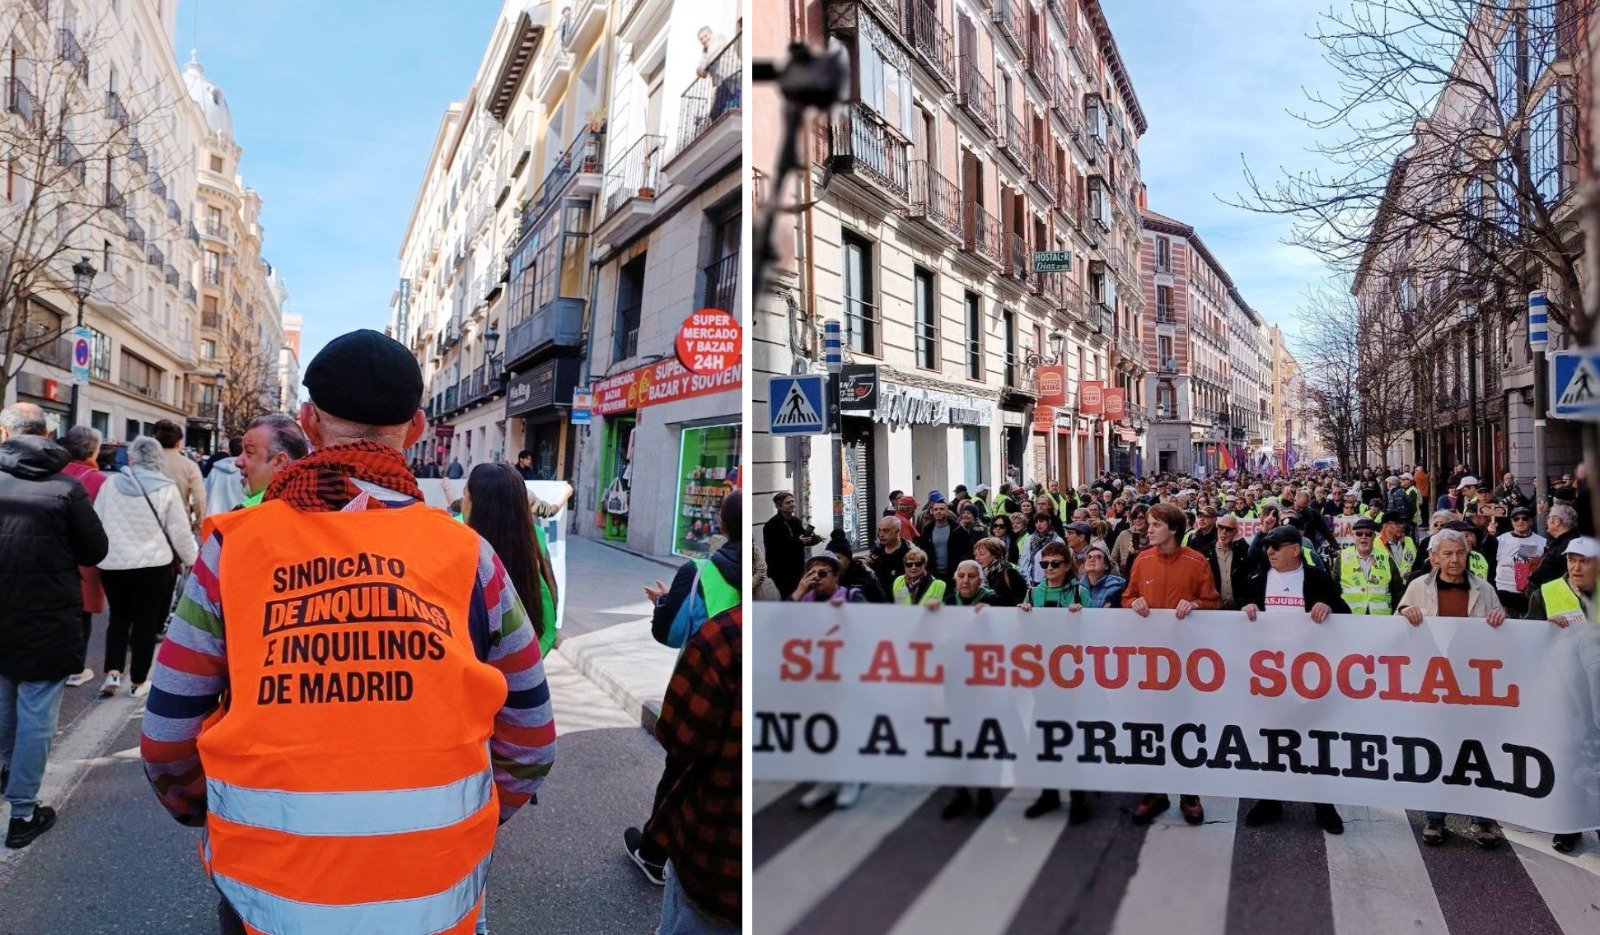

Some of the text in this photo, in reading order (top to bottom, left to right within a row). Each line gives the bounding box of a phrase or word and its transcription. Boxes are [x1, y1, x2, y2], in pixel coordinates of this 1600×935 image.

[693, 315, 730, 326] SUPER
[683, 328, 738, 339] MERCADO
[686, 342, 734, 352] Y BAZAR
[693, 355, 724, 369] 24H
[610, 372, 635, 388] MERCADO
[648, 382, 679, 400] BAZAR
[682, 376, 690, 393] Y
[604, 388, 621, 401] BAZAR
[273, 552, 405, 593] SINDICATO
[269, 586, 447, 631] DE INQUILINAS
[263, 630, 446, 668] E INQUILINOS
[779, 624, 1520, 708] SÍ AL ESCUDO SOCIAL
[257, 671, 414, 705] DE MADRID
[753, 711, 1556, 799] NO A LA PRECARIEDAD
